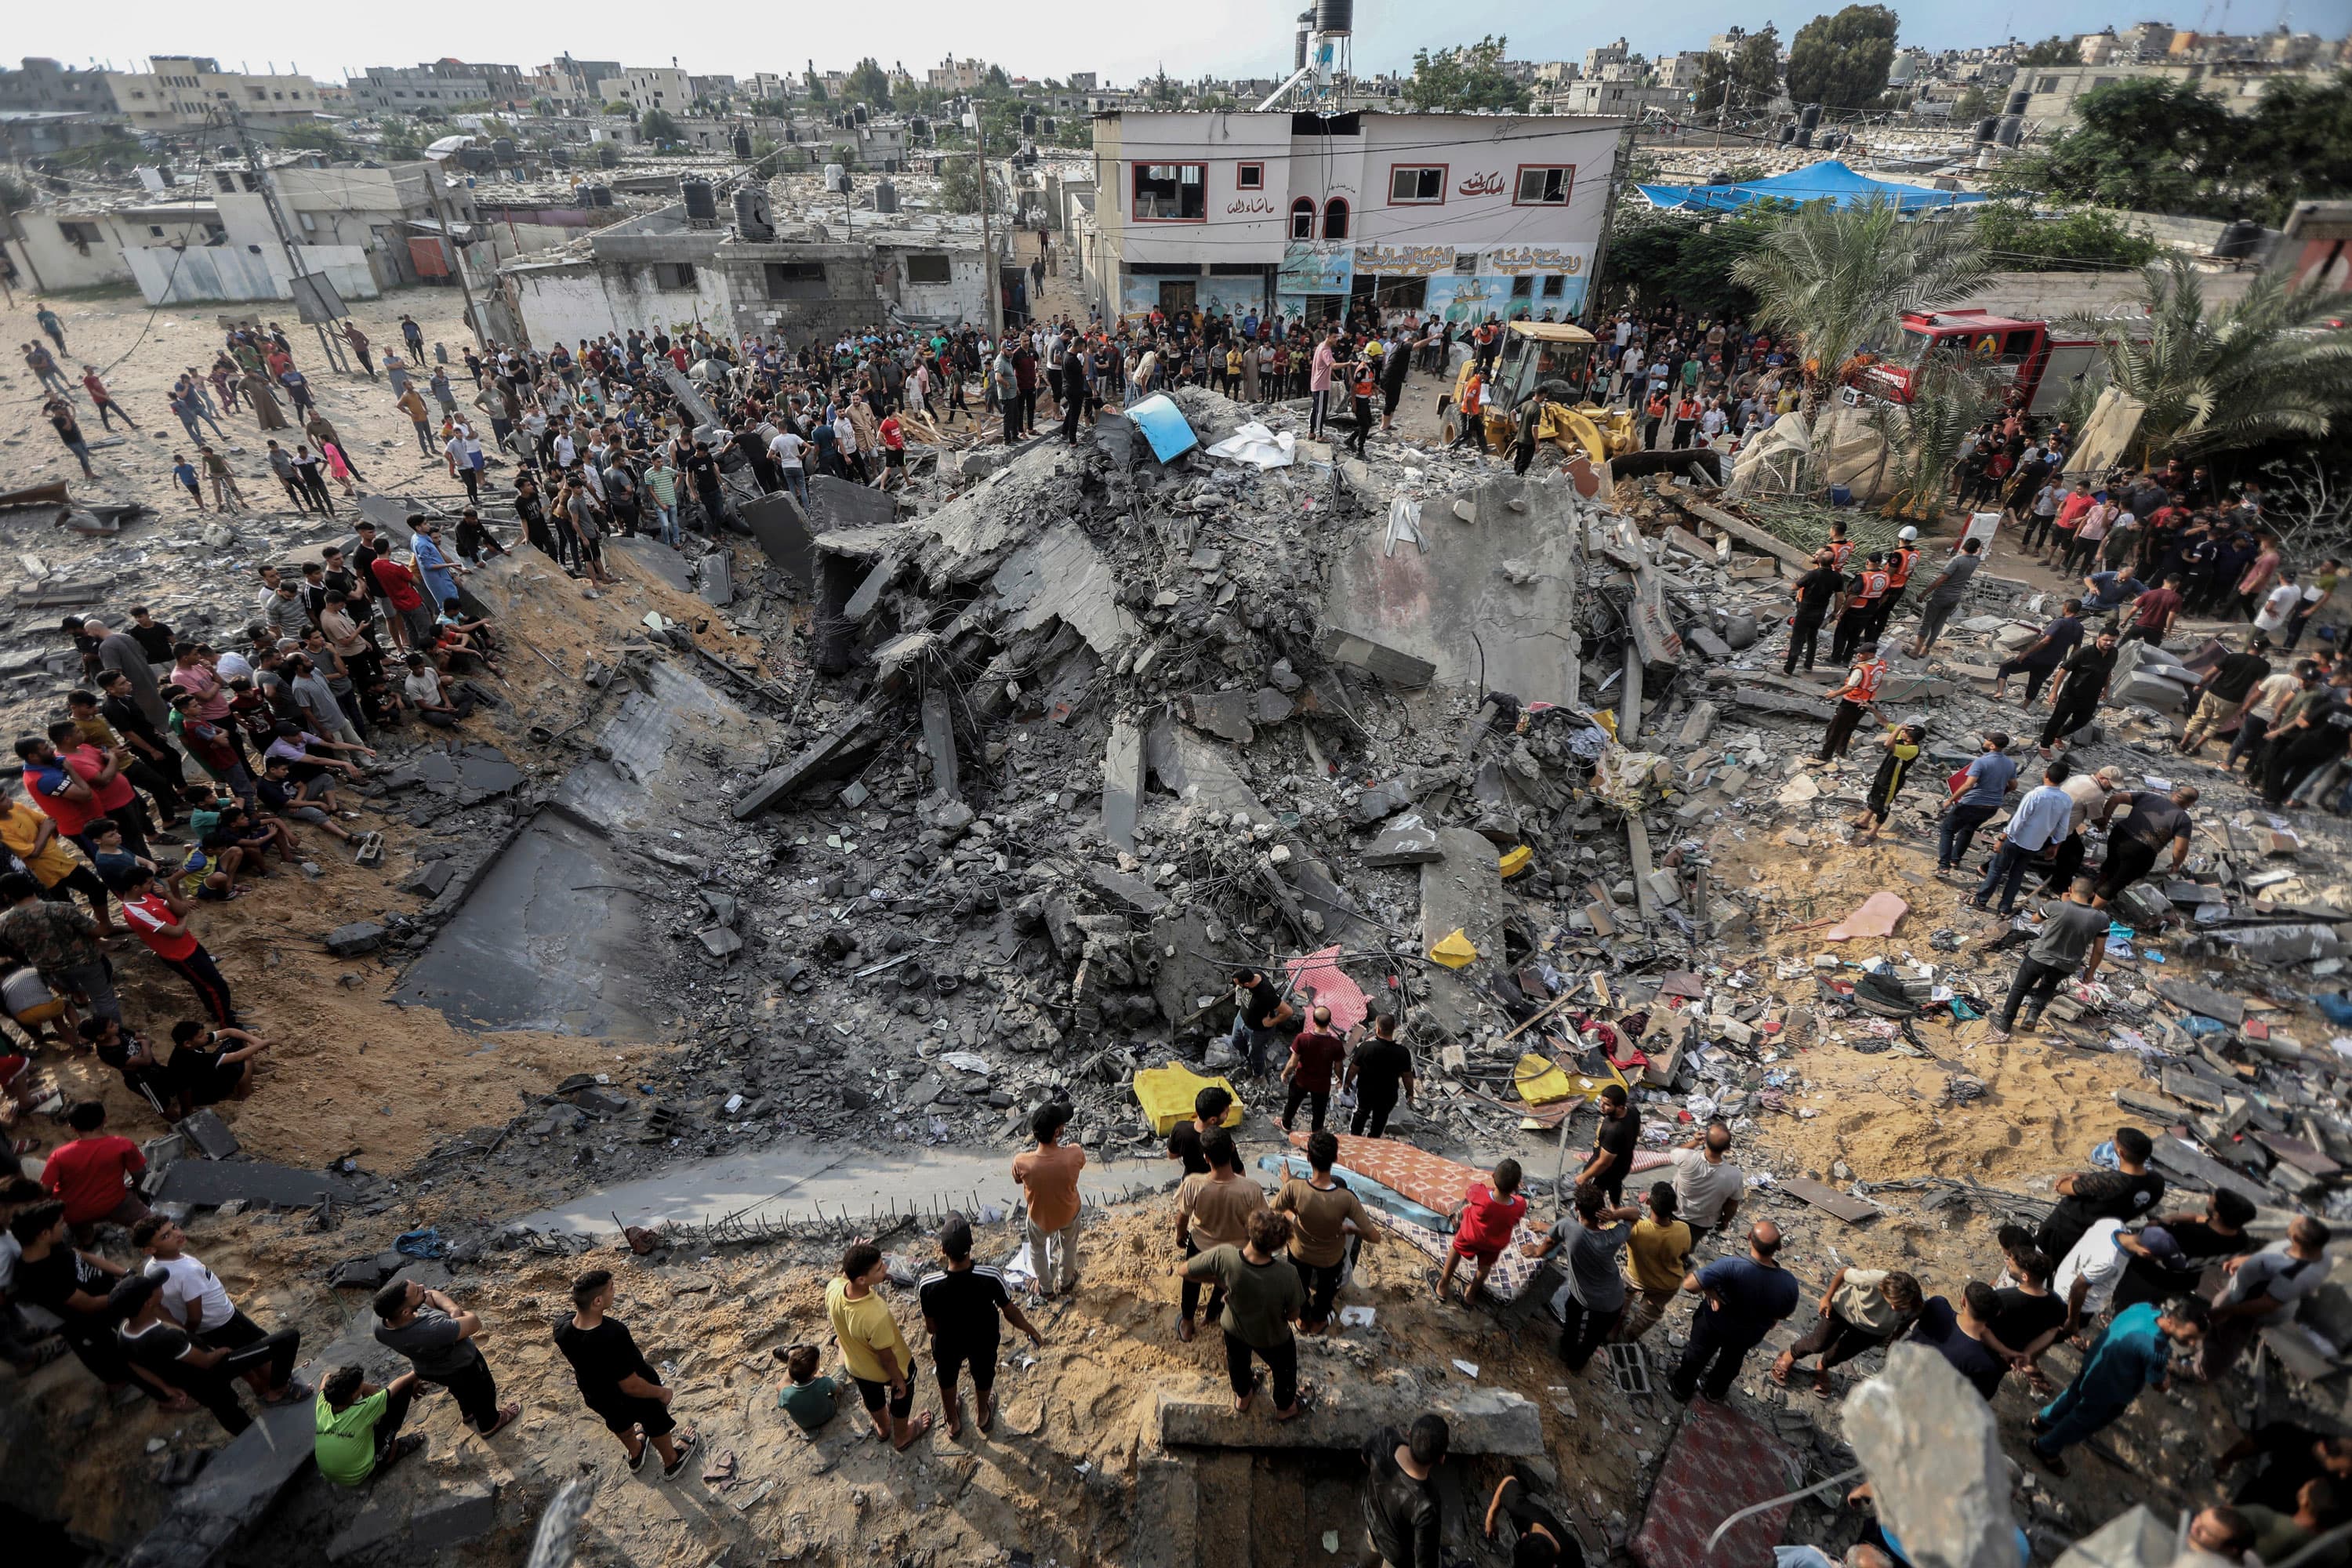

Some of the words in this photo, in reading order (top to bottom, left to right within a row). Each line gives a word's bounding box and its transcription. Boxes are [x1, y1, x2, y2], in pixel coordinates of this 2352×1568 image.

[1227, 198, 1245, 214] الله
[1493, 246, 1535, 274] طيبة
[1532, 246, 1582, 274] روضة
